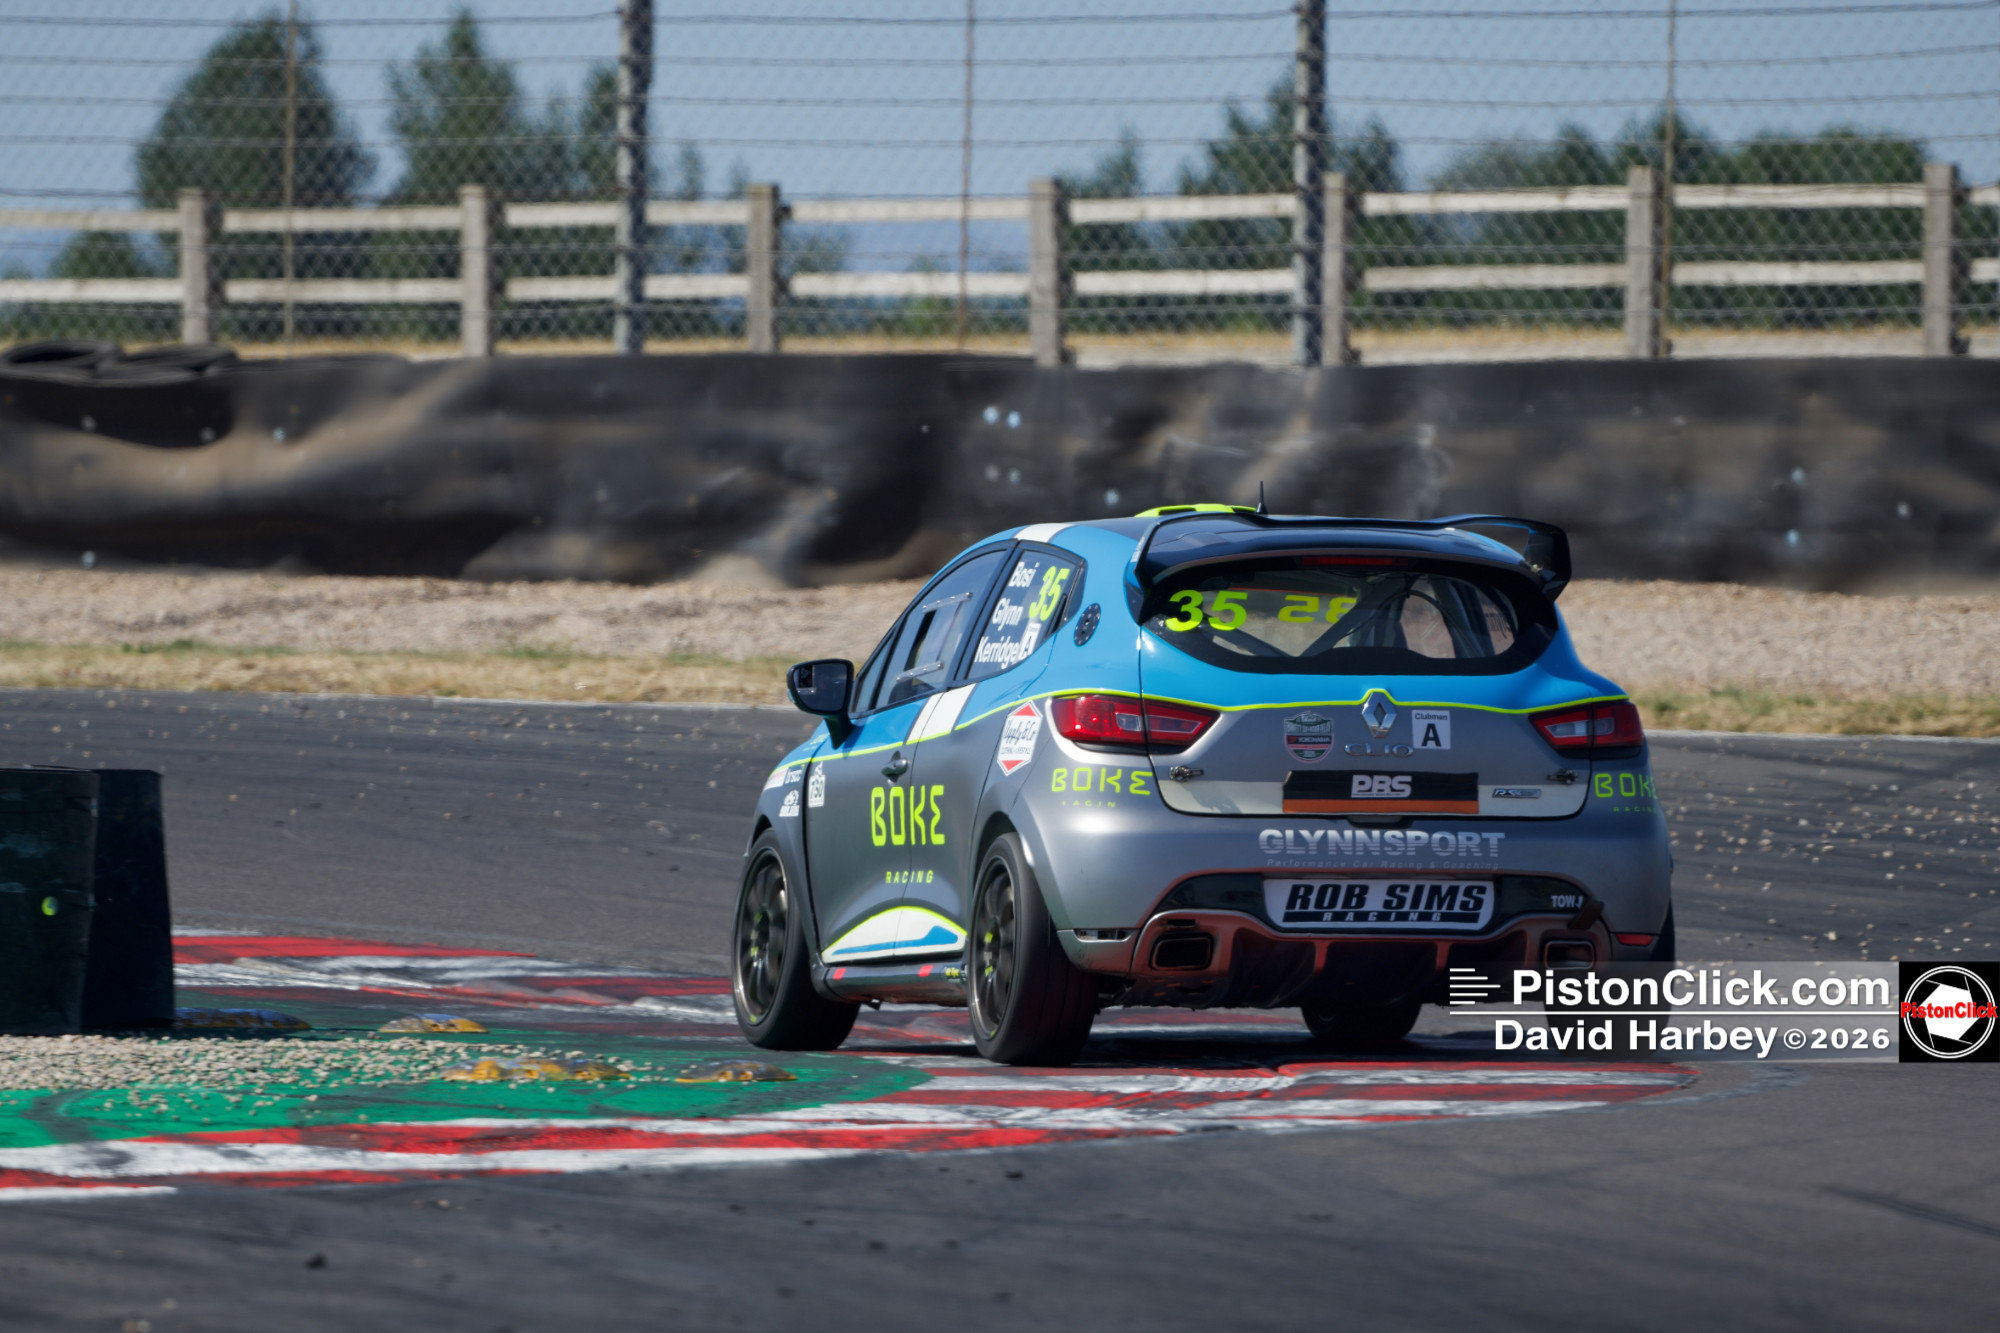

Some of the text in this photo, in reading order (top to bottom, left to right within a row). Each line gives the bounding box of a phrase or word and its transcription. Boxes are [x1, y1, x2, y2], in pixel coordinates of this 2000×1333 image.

[1008, 561, 1040, 588] Bosi
[1028, 566, 1071, 621] 35
[992, 597, 1023, 631] Glynn
[1165, 589, 1248, 632] 35
[974, 635, 1020, 670] Kerridge
[1414, 712, 1448, 721] Clubman
[1421, 723, 1442, 747] A
[1344, 743, 1414, 758] CLIO
[1051, 767, 1153, 796] BOKE
[1351, 774, 1413, 798] PBS
[871, 784, 946, 847] BOKE
[1258, 828, 1506, 856] GLYNNSPORT
[1266, 858, 1347, 868] Performance
[885, 870, 934, 884] RACING
[1285, 883, 1488, 912] ROB SIMS
[1322, 912, 1442, 922] RACING
